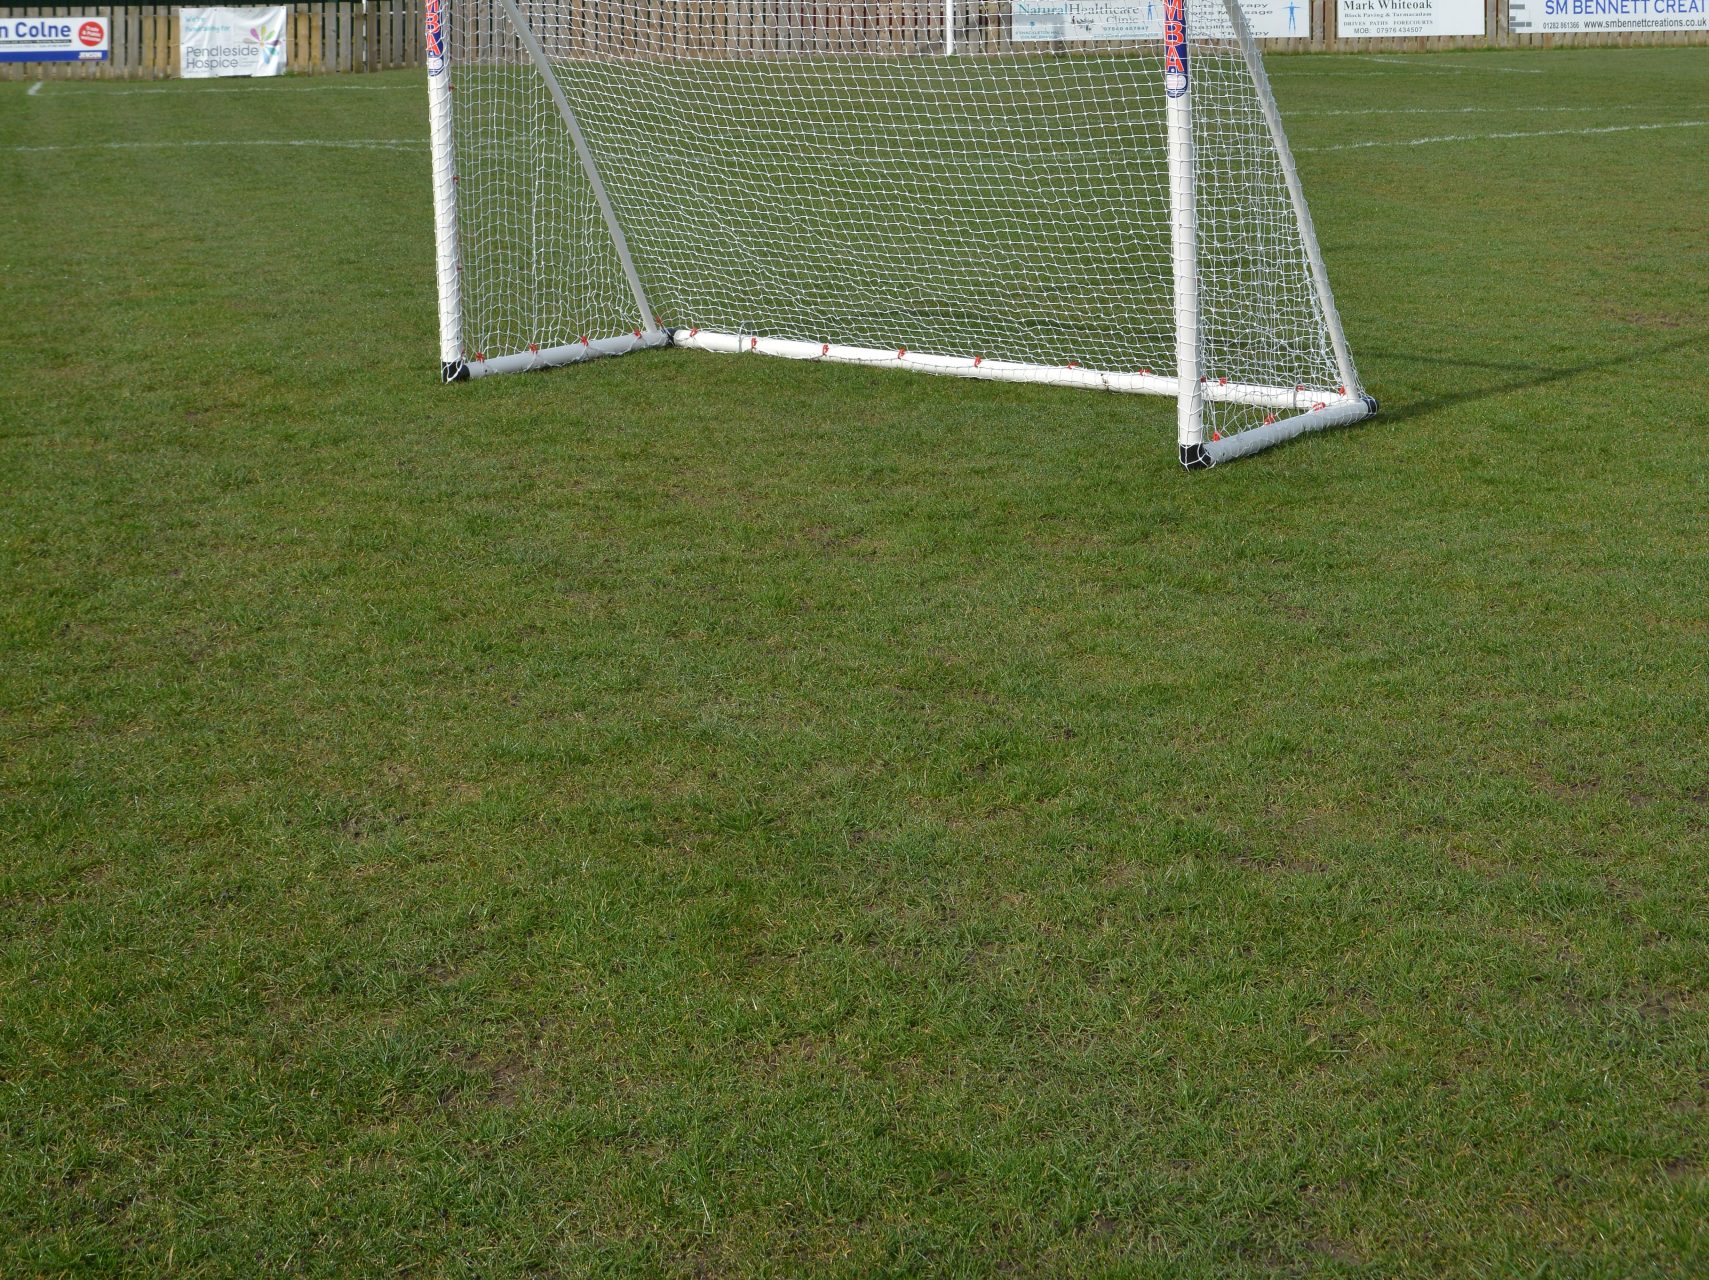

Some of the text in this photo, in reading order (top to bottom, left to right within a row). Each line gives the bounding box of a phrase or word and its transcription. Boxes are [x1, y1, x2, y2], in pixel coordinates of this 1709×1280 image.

[1343, 0, 1433, 11] Mark Whiteoak
[1545, 0, 1568, 15] SM
[1106, 15, 1138, 24] Clinic
[1583, 17, 1707, 29] www.smbennettcreations.co.uk
[15, 21, 71, 38] Colne
[186, 45, 259, 57] Pendleside
[186, 58, 239, 70] Hospice
